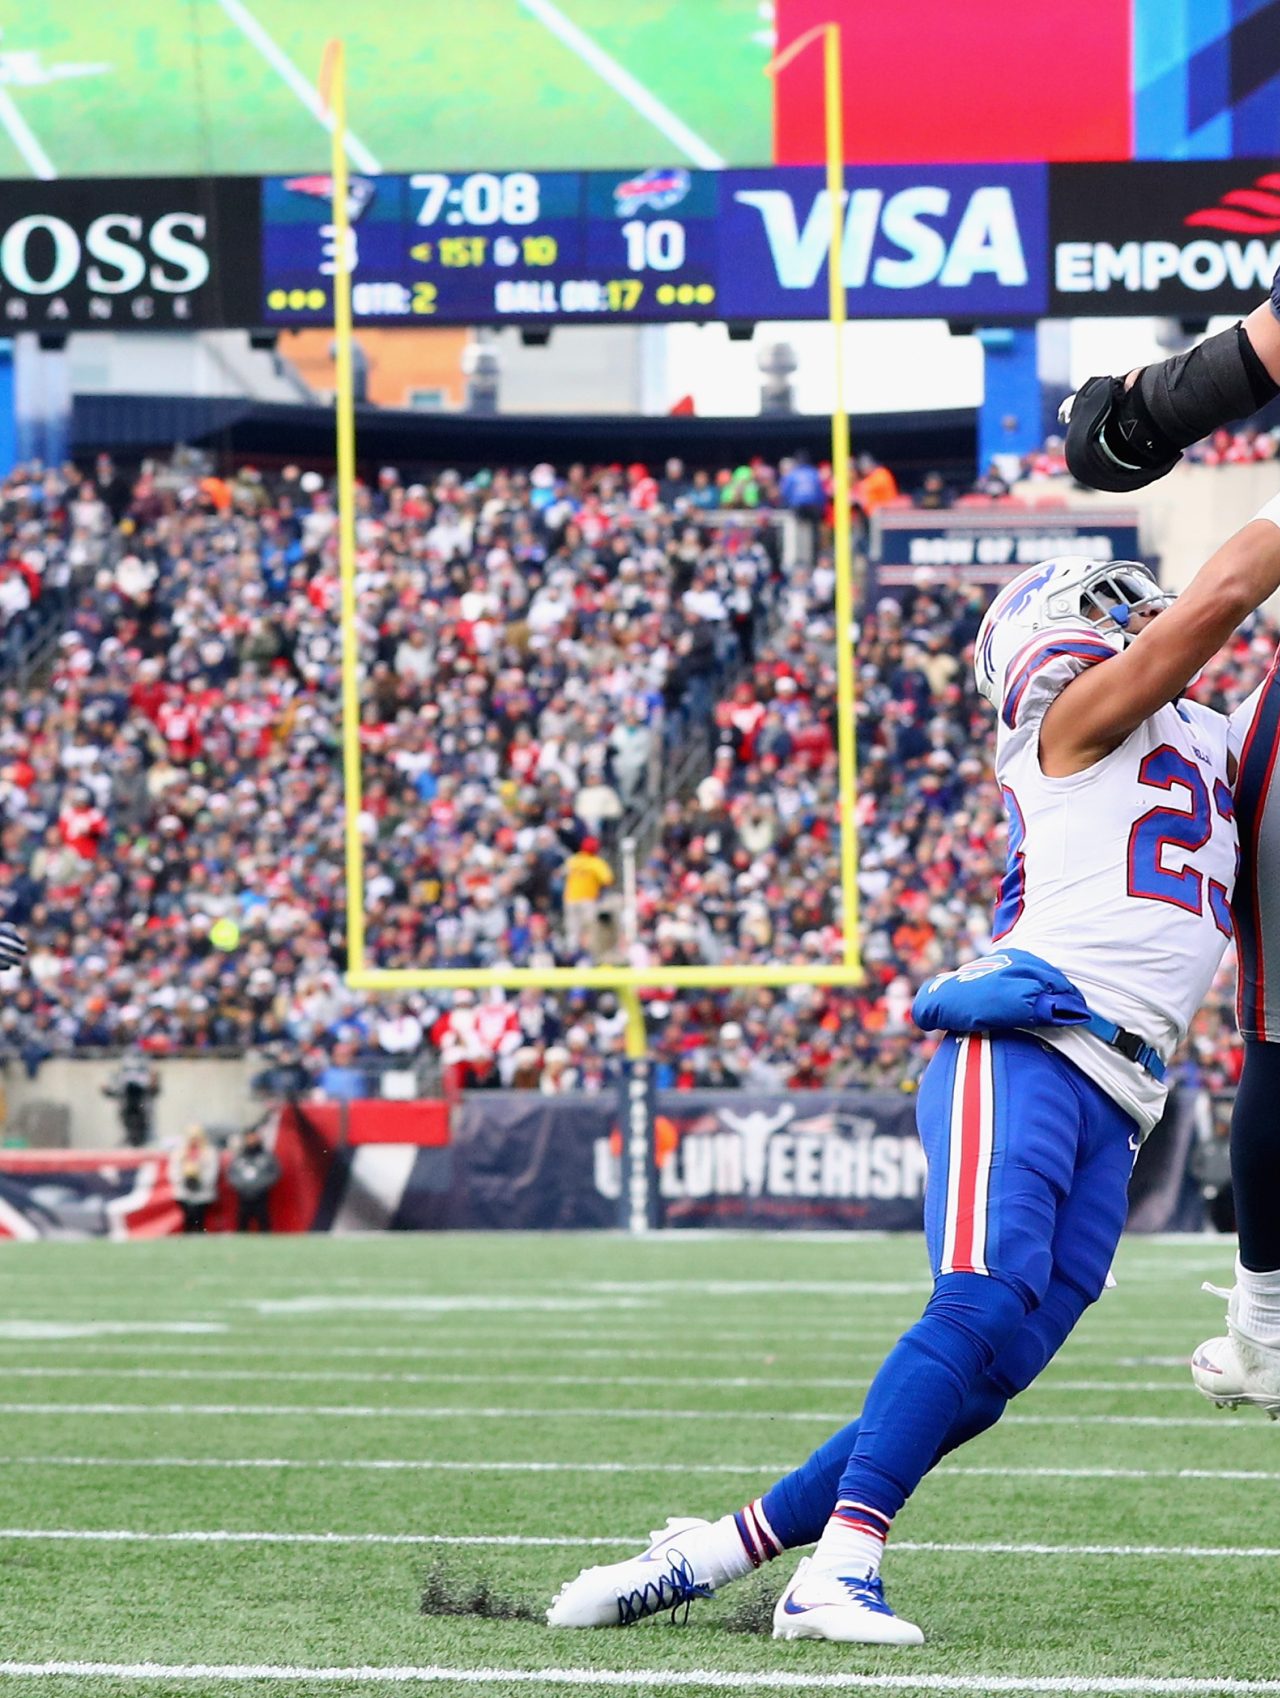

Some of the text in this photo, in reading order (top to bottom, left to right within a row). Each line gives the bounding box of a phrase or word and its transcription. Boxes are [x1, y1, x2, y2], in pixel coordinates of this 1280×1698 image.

[410, 173, 540, 226] 7:08
[318, 223, 359, 274] 3
[621, 219, 686, 271] 10
[735, 186, 1028, 288] VISA
